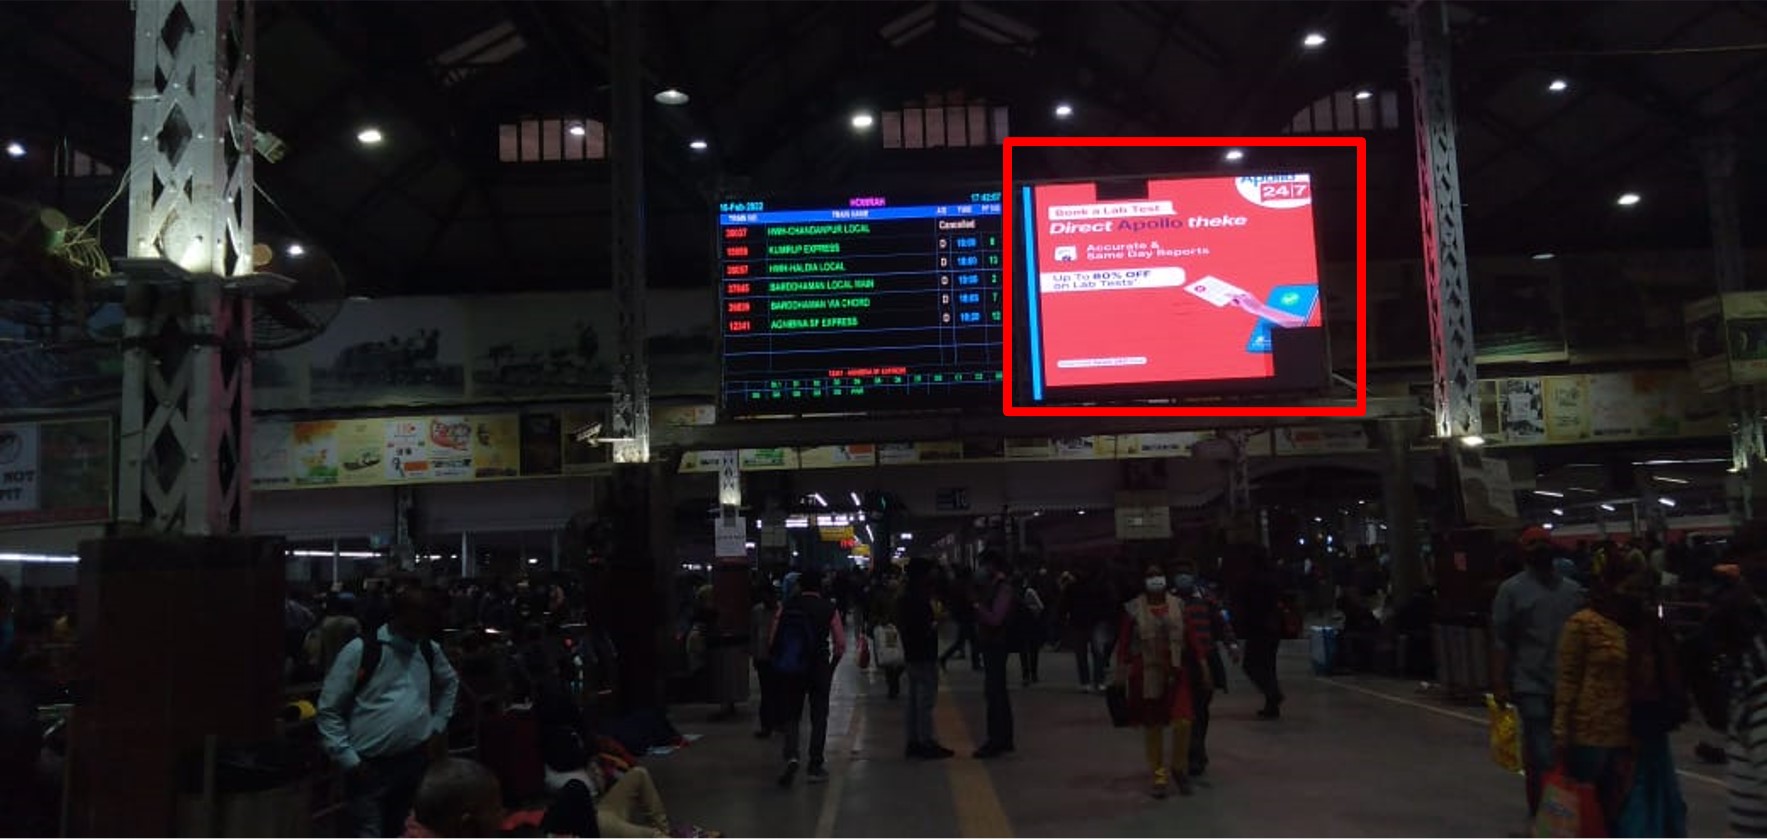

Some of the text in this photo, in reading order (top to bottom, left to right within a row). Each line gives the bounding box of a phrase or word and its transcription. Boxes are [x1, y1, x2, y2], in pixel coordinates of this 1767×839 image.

[1102, 205, 1126, 216] Lab
[1130, 203, 1160, 213] Test
[844, 223, 871, 234] LOCAL
[1049, 214, 1248, 235] Direct Apollo theke
[1086, 242, 1147, 252] Accurate
[1087, 251, 1124, 261] Same
[818, 260, 846, 272] LOCAL
[1051, 274, 1071, 284] Up
[1125, 269, 1150, 279] OFF
[826, 279, 853, 291] LOCAL
[1072, 281, 1096, 289] Lab
[4, 470, 35, 482] NOT
